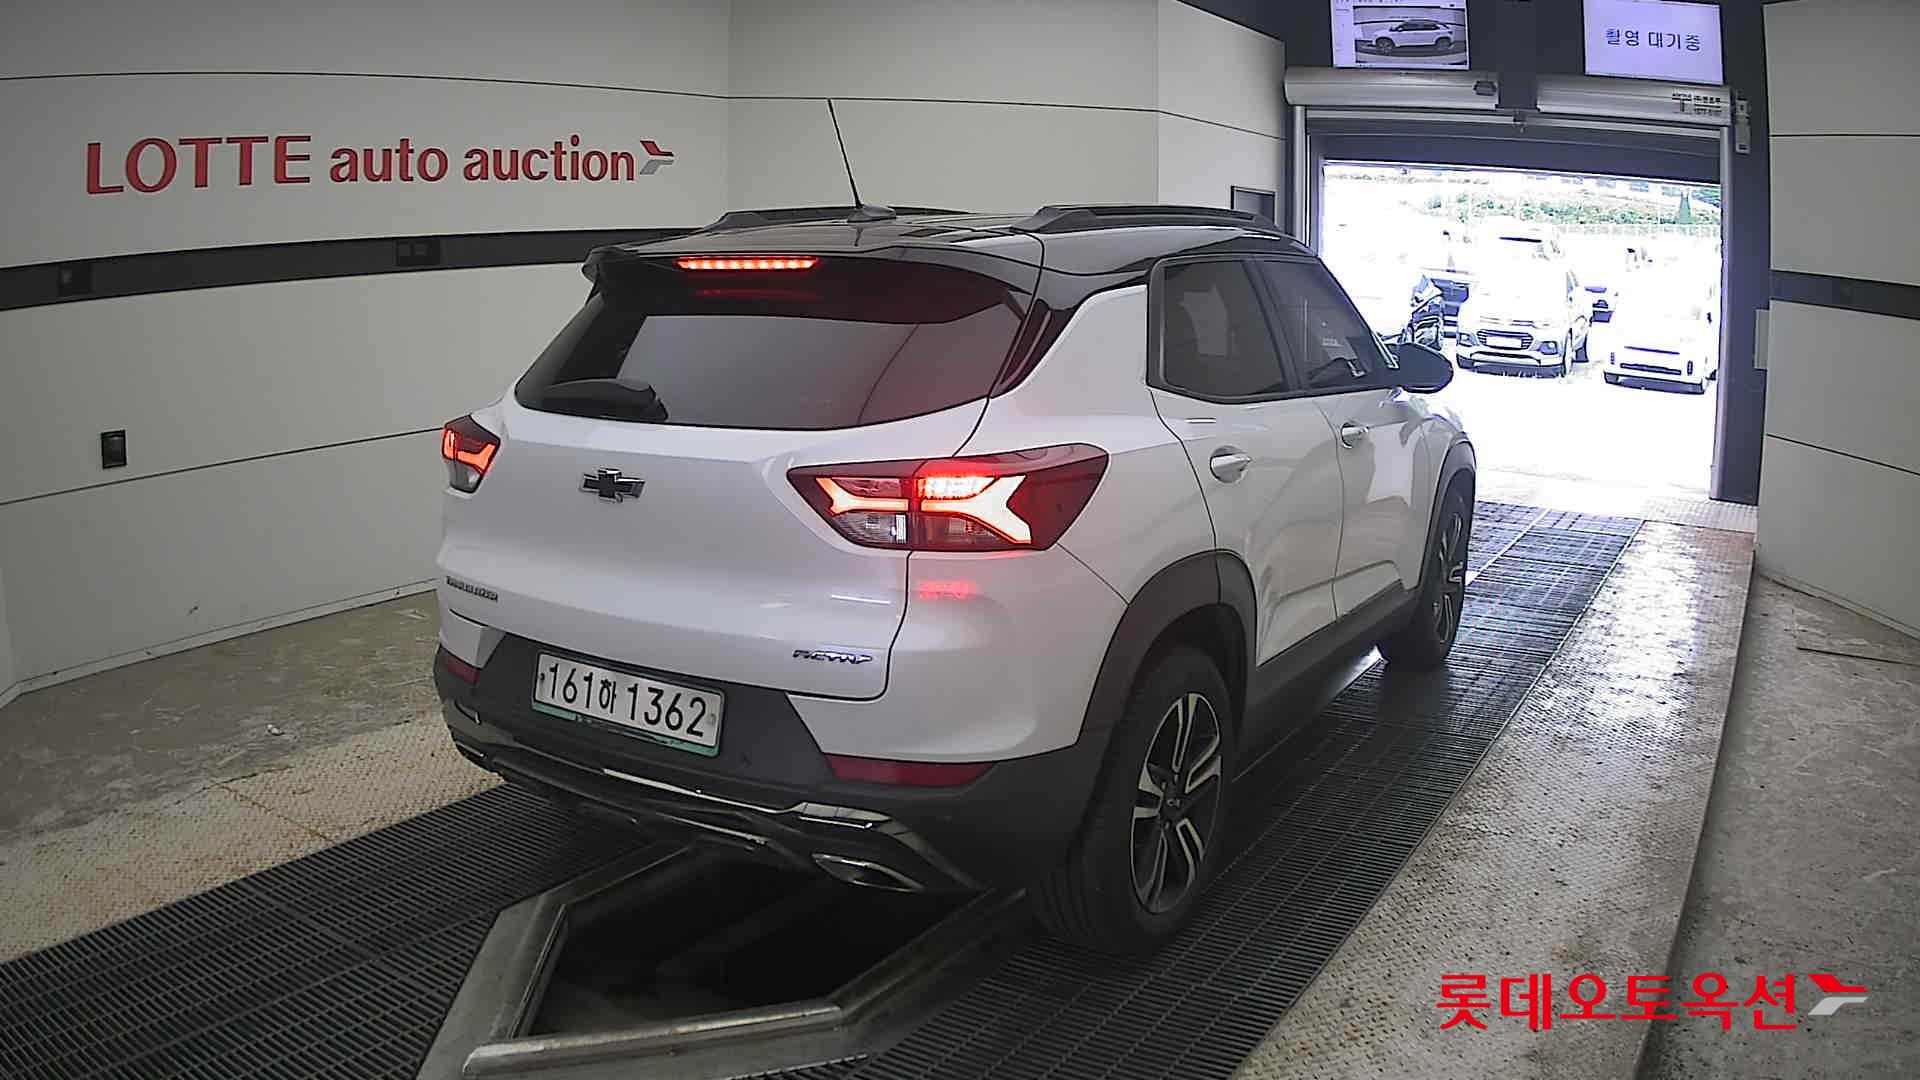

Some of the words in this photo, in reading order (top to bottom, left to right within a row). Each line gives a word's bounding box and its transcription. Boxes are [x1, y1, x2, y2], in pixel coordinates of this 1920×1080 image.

[1647, 31, 1701, 51] 대기중
[86, 135, 312, 194] LOTTE
[329, 138, 449, 183] auto
[463, 134, 635, 182] auction
